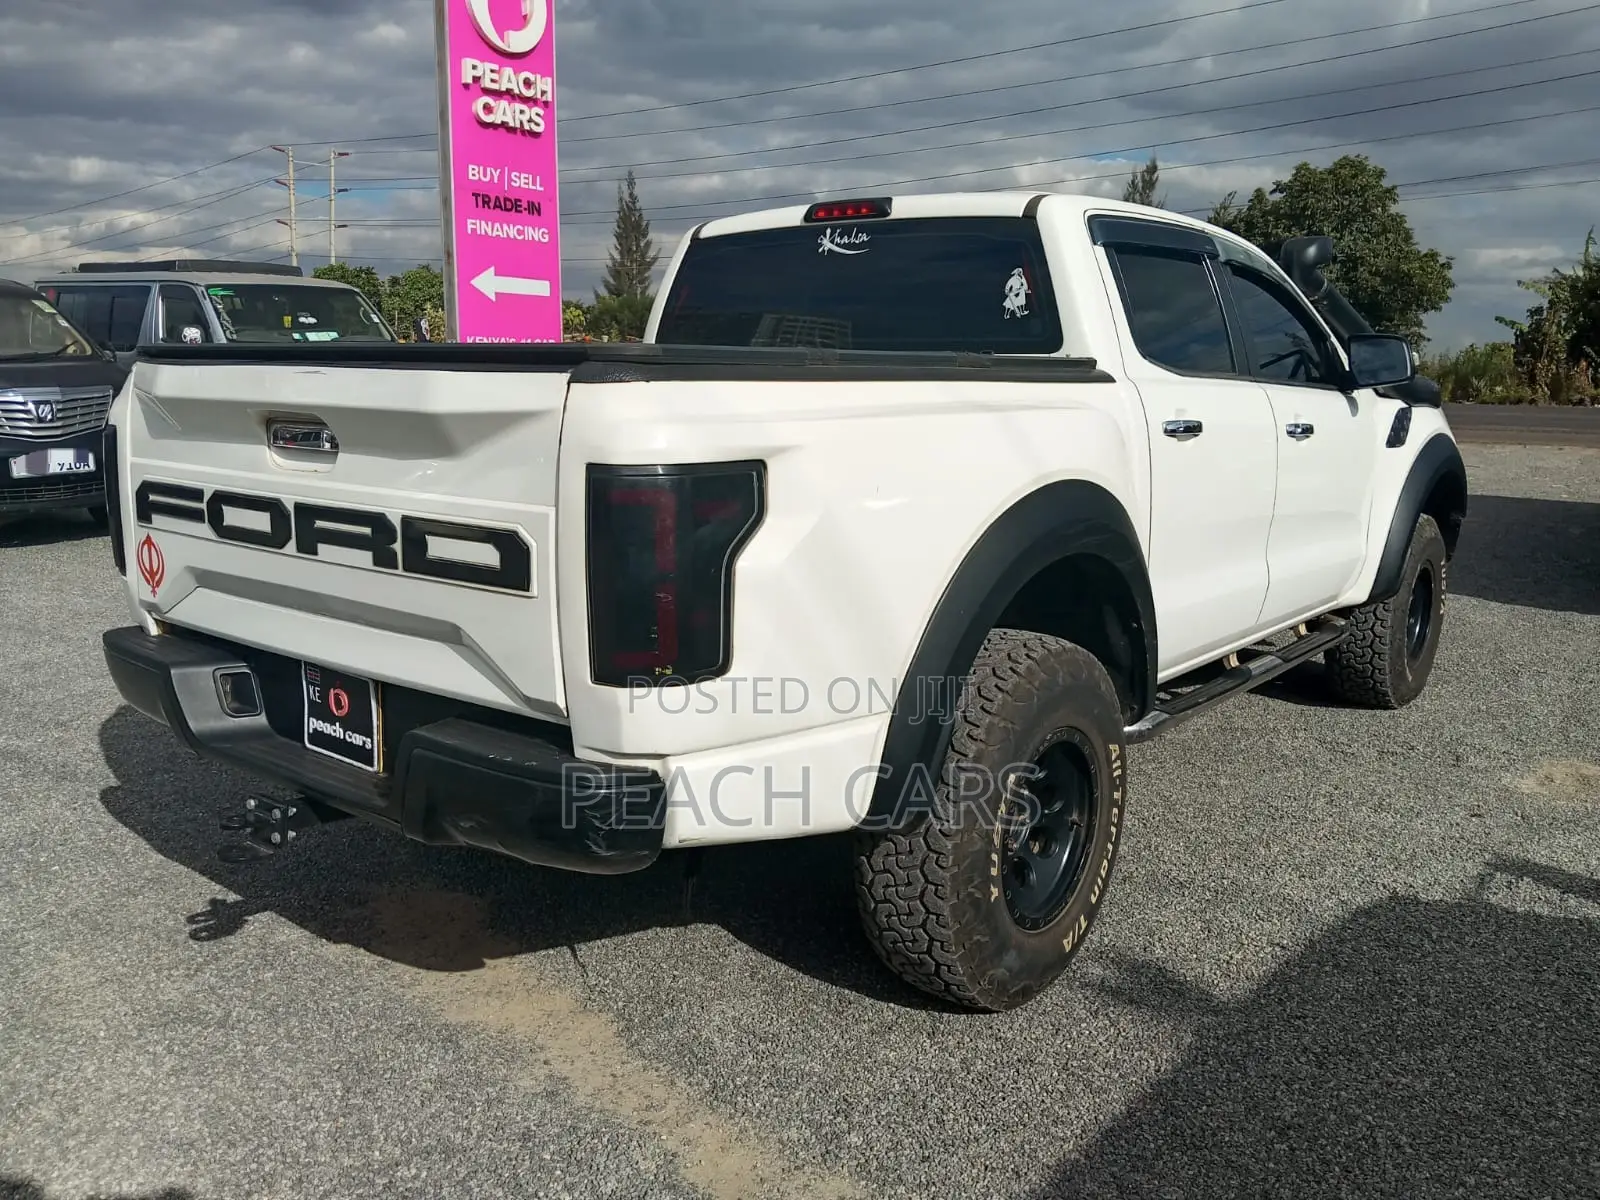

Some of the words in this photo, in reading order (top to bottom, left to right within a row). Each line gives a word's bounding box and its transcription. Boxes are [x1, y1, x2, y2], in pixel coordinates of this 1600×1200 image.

[461, 57, 553, 102] PEACH
[472, 95, 546, 134] CARS
[468, 164, 501, 184] BUY
[511, 172, 544, 191] SELL
[472, 192, 541, 217] TRADE-IN
[467, 218, 549, 243] FINANCING
[135, 479, 533, 594] FORD
[309, 684, 321, 703] KE
[309, 717, 344, 740] peach
[345, 731, 372, 750] cars
